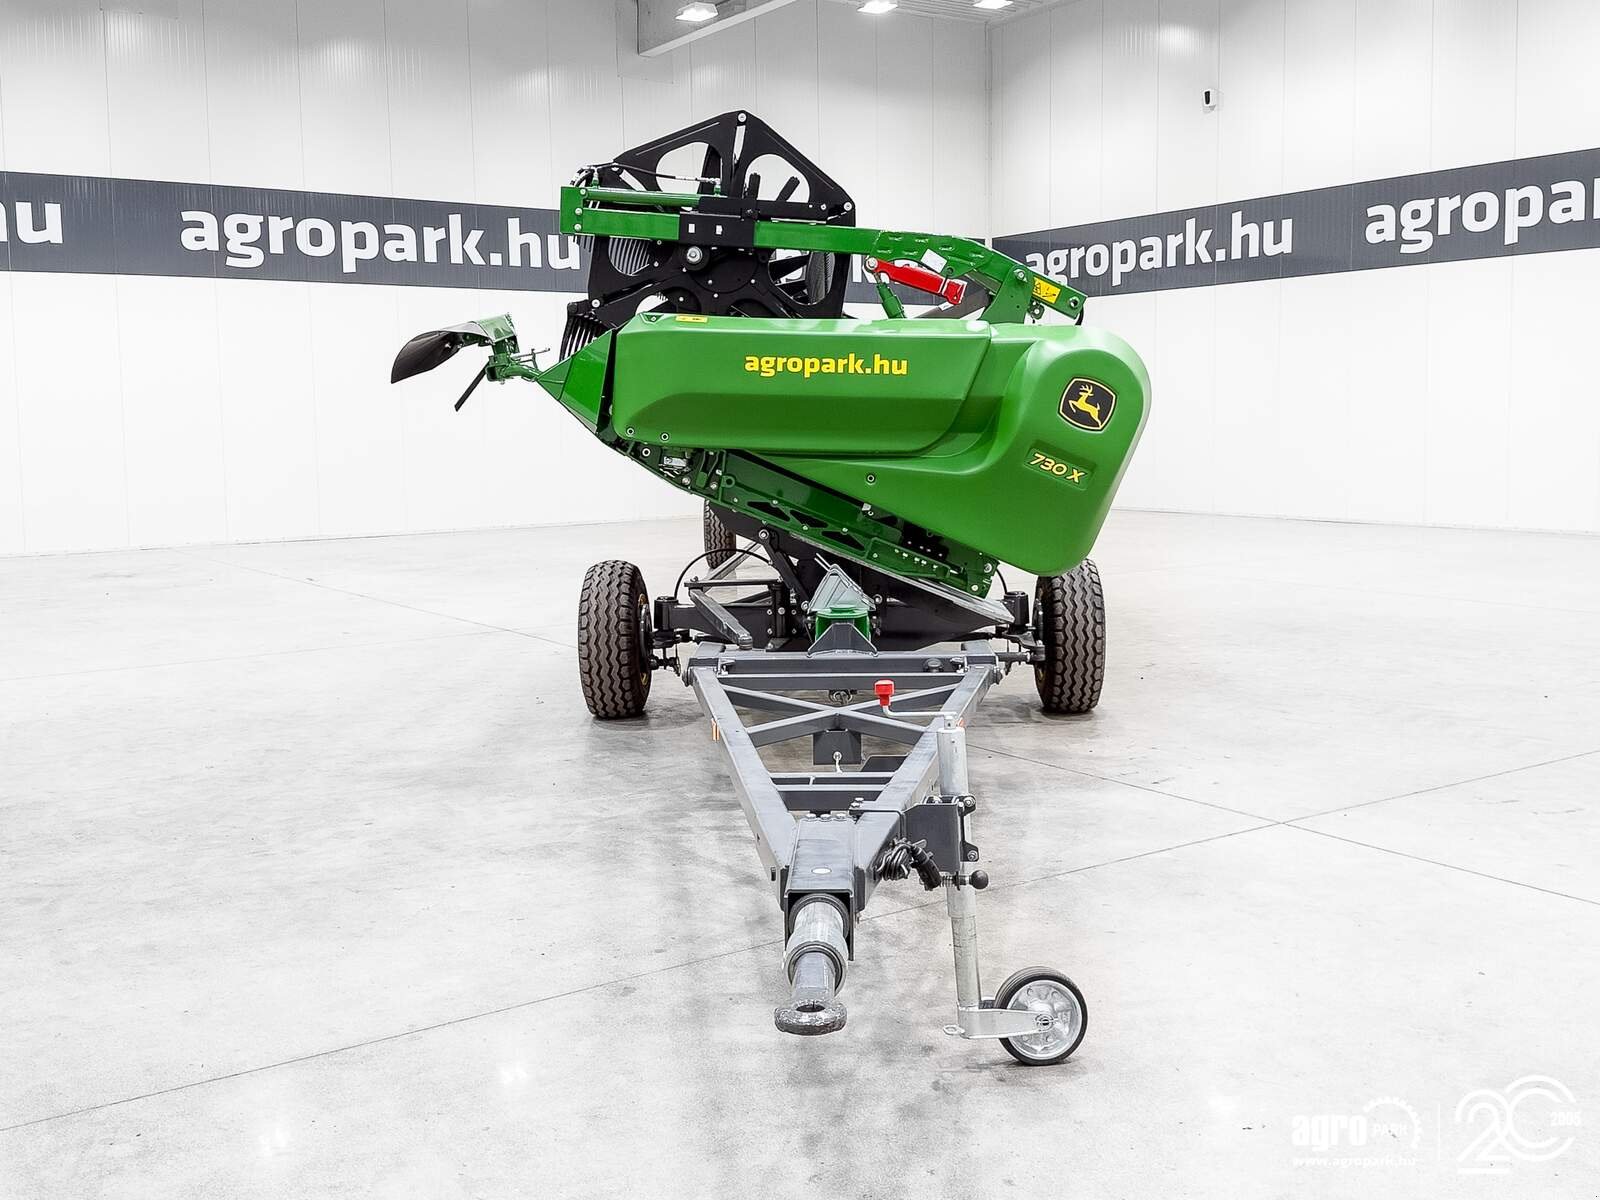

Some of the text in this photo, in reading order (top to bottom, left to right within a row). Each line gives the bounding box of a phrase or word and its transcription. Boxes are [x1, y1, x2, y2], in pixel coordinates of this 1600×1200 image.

[0, 201, 63, 244] u
[1365, 177, 1600, 254] agropa
[179, 208, 581, 273] agropark.hu
[744, 353, 908, 378] agropark.hu
[1029, 452, 1086, 484] 730 X
